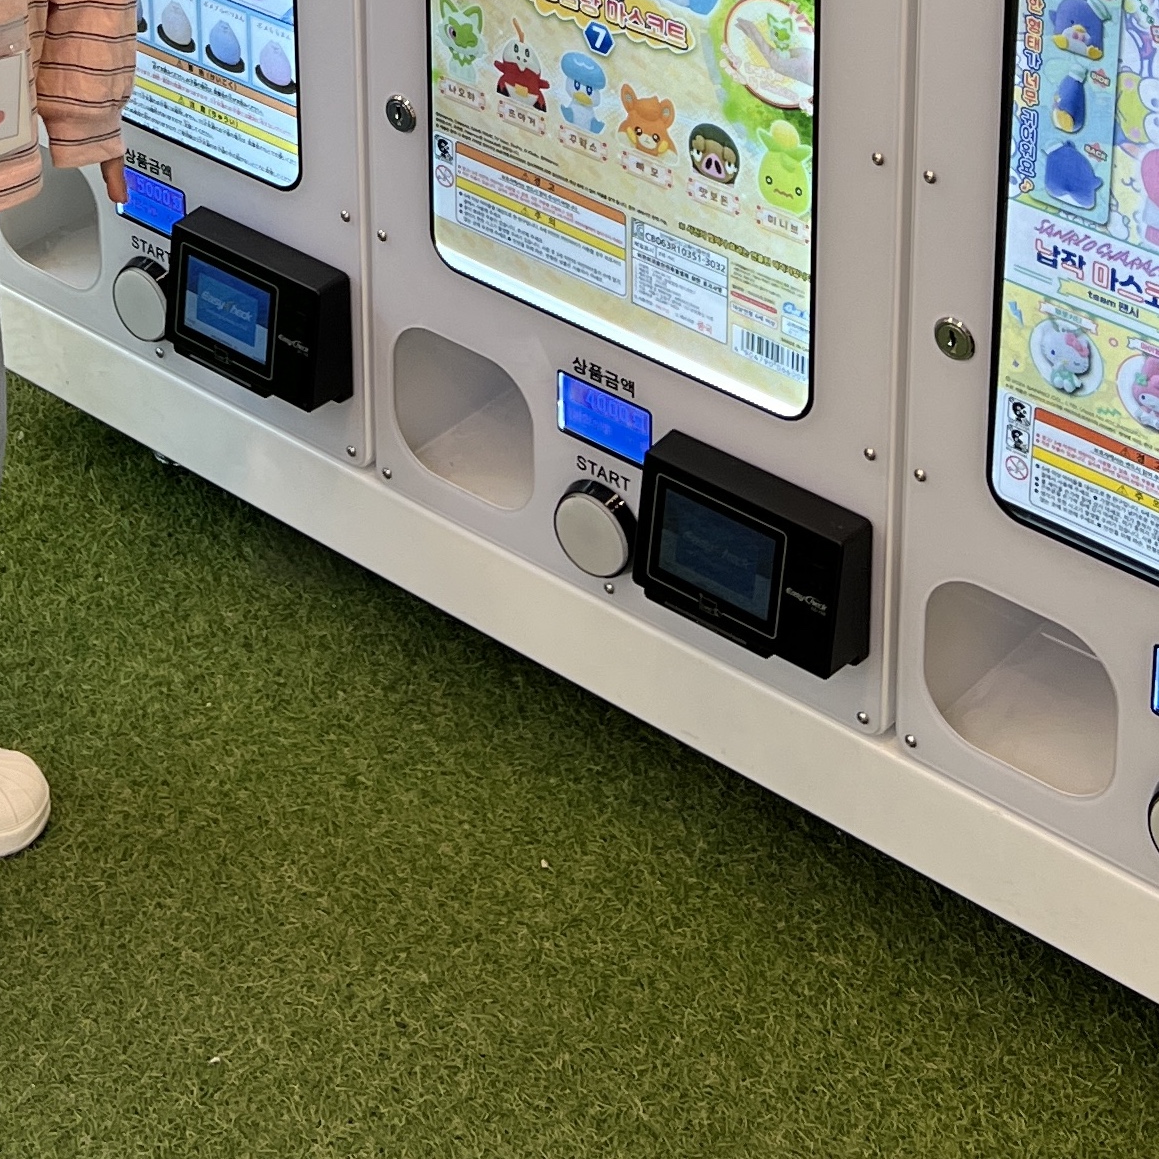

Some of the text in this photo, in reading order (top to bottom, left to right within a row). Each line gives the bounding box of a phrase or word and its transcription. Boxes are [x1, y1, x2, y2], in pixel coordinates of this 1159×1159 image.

[592, 27, 607, 50] 7
[605, 0, 689, 50] 마스코트
[448, 83, 476, 103] 나오하
[1090, 70, 1111, 87] SIDE
[125, 148, 173, 181] 상품금액
[1084, 144, 1108, 162] BACK
[697, 185, 730, 208] 맛보돈
[766, 214, 800, 235] 미니브
[1034, 218, 1098, 253] SANRIO
[644, 231, 727, 274] CB063R10351-3032
[1035, 238, 1087, 282] 납작
[1088, 290, 1141, 319] team 팬시
[572, 356, 636, 398] 상품금액
[576, 454, 631, 492] START
